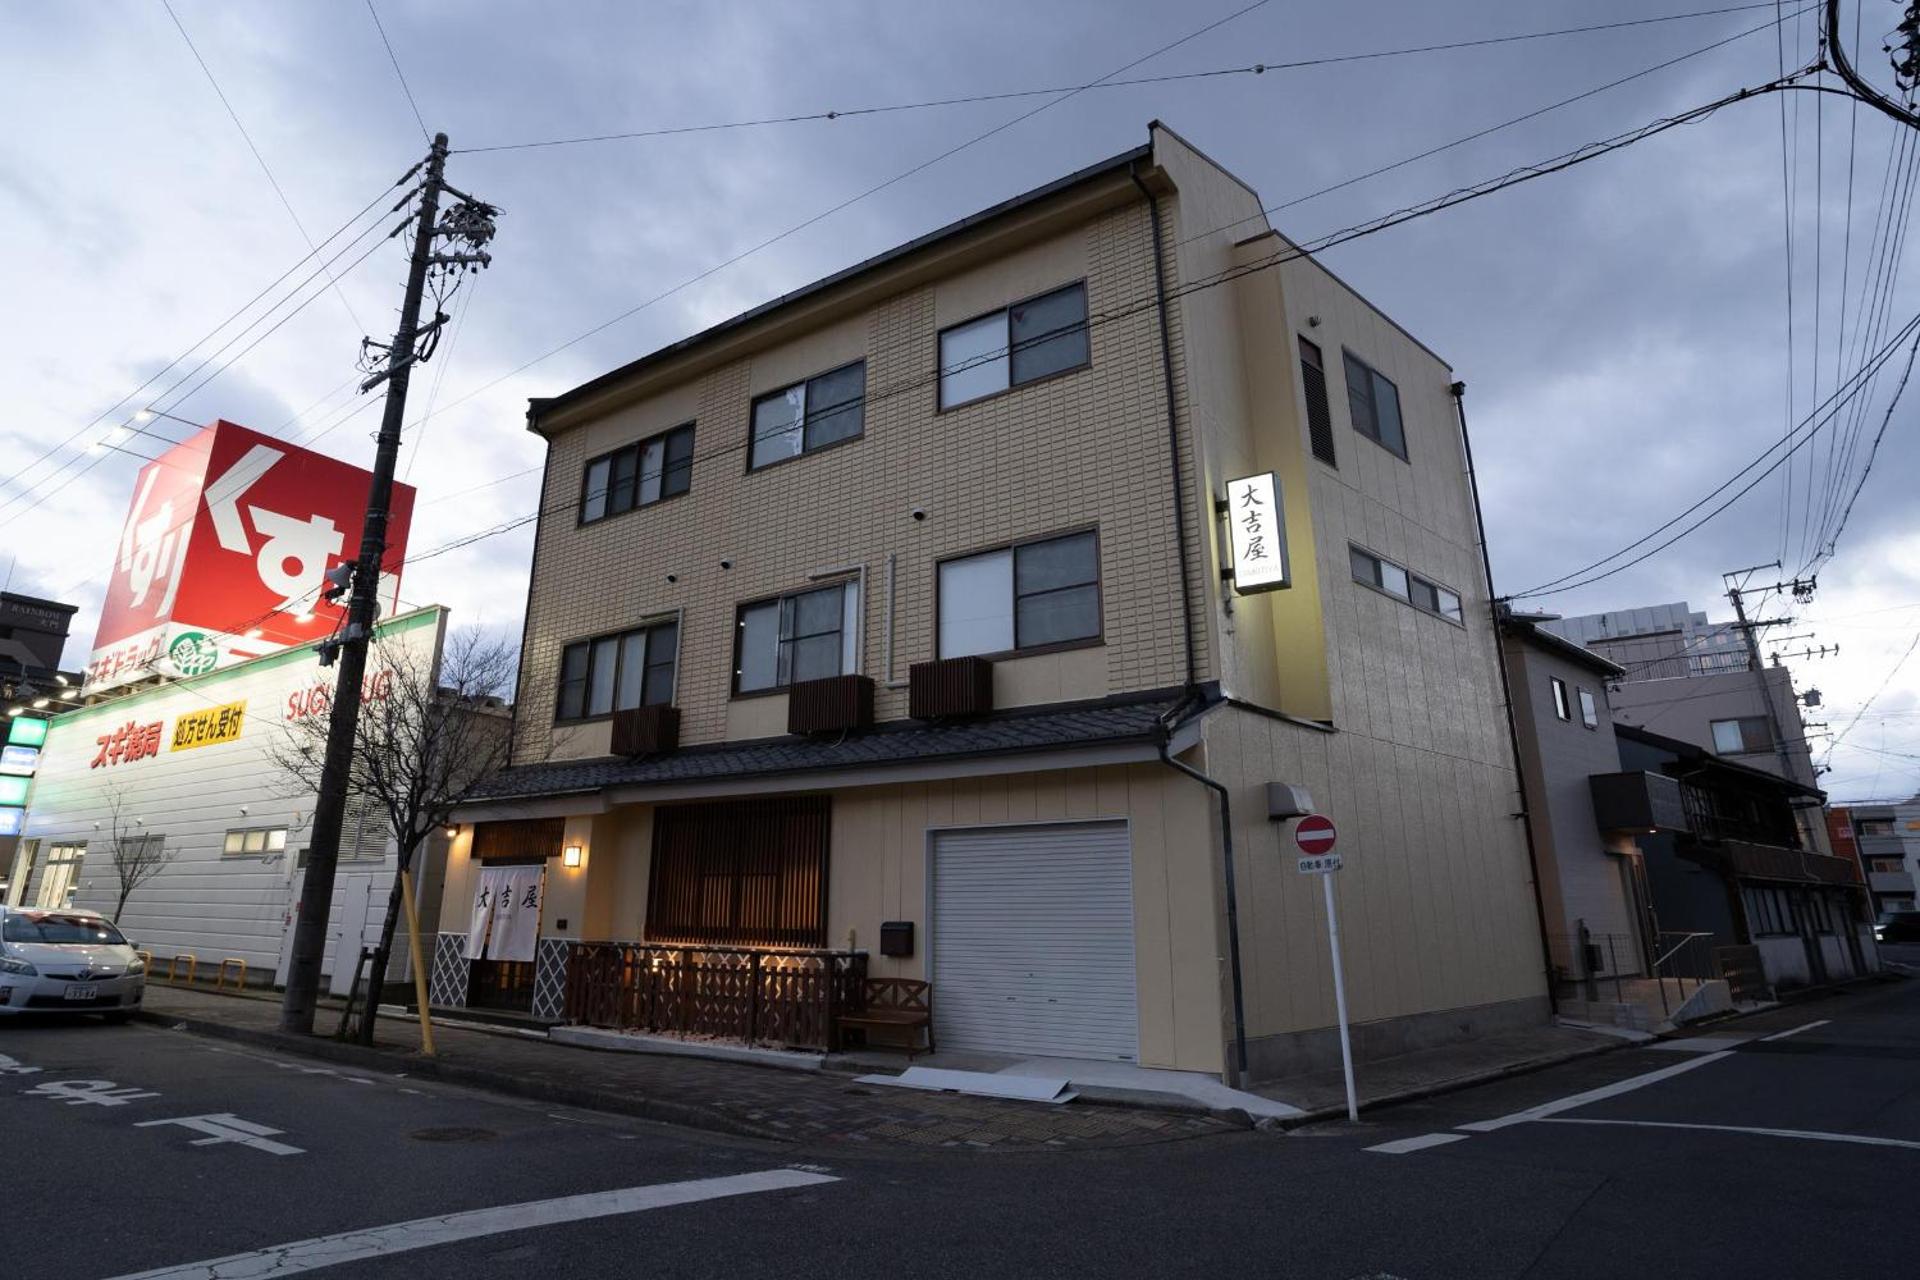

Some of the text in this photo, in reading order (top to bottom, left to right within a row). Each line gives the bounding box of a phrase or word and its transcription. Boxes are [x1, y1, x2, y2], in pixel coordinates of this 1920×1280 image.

[1241, 484, 1268, 561] 大吉屋
[91, 720, 164, 769] スギ薬局
[174, 706, 242, 746] 処方せん受付
[478, 884, 538, 909] 大吉屋
